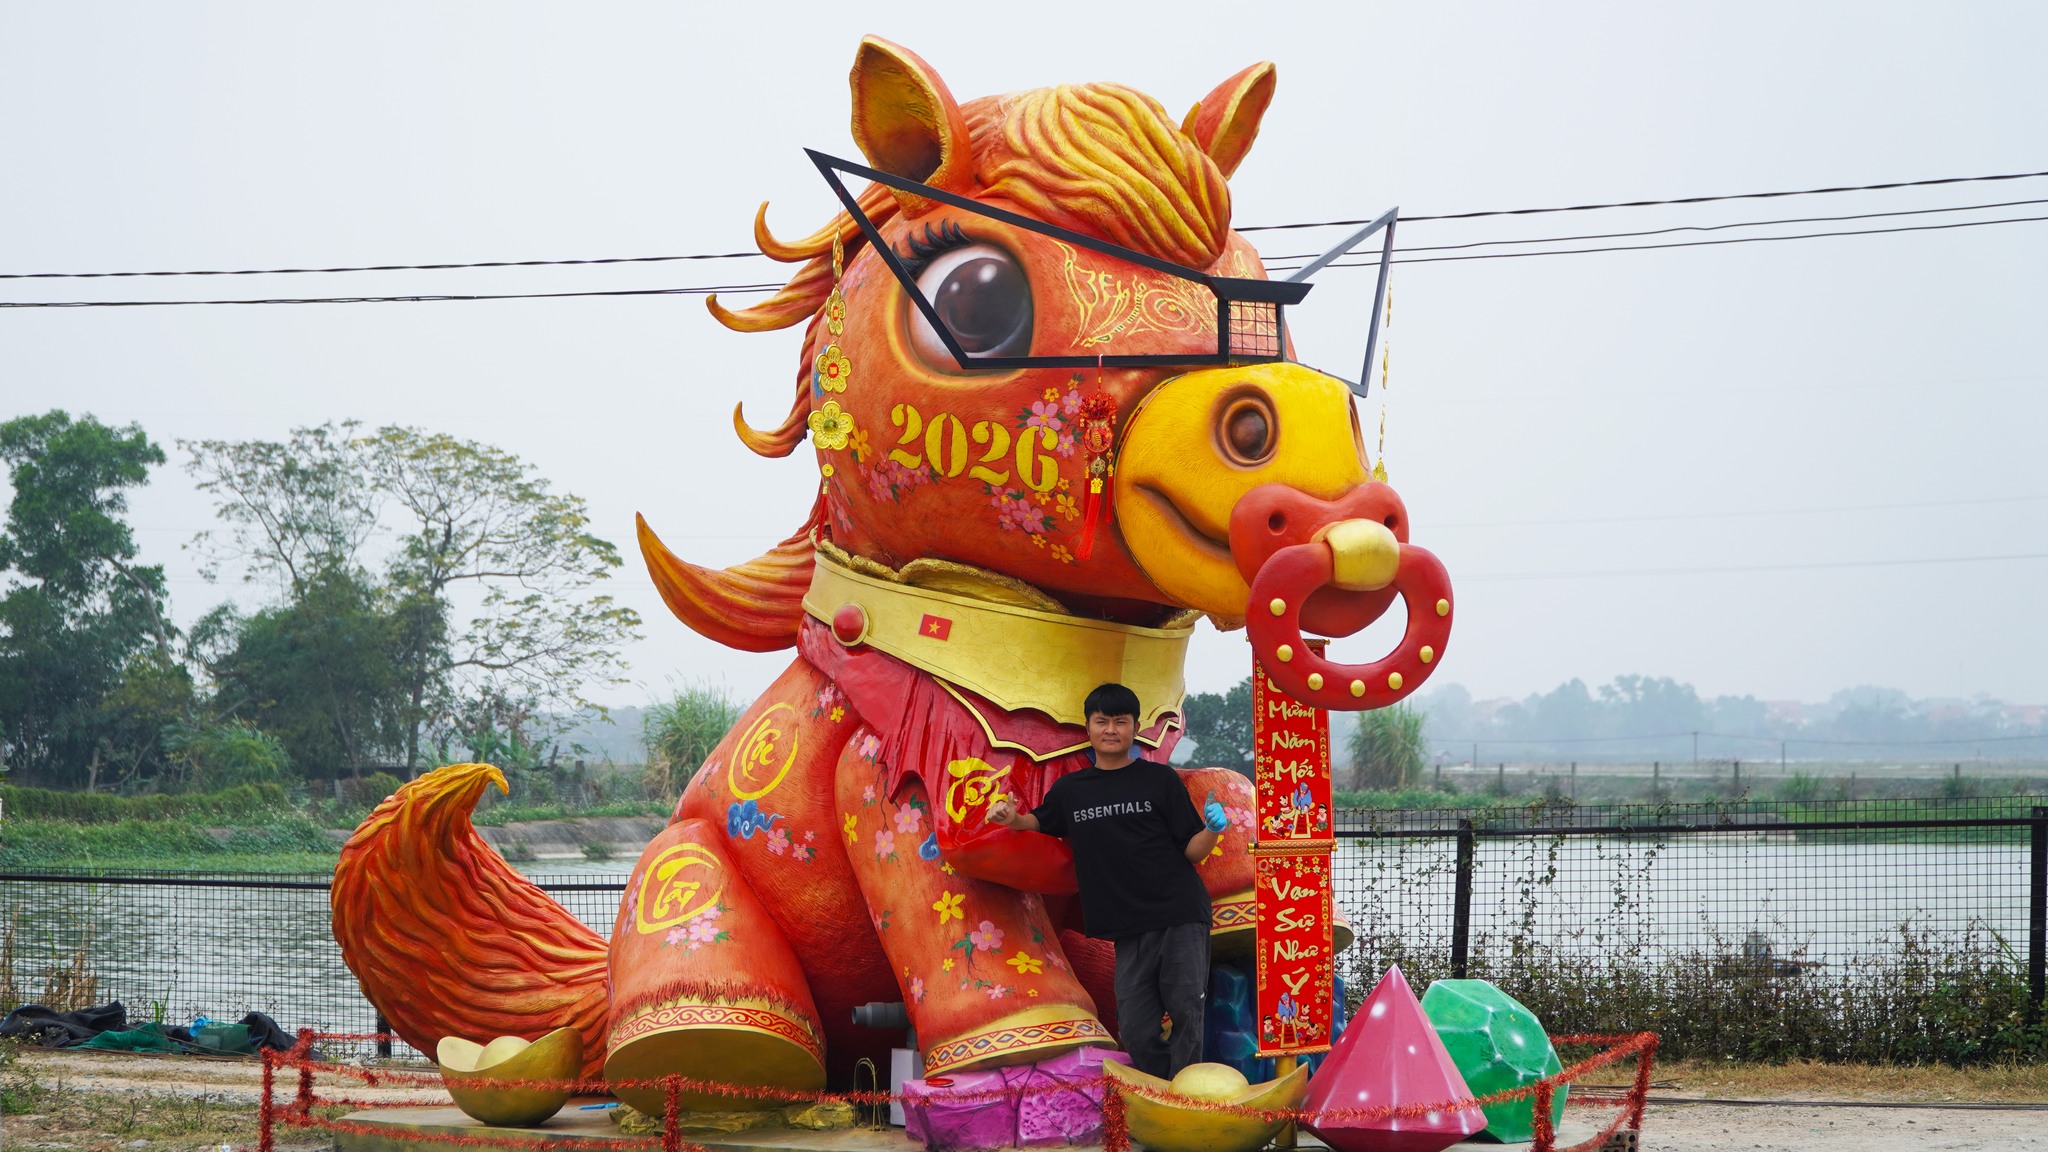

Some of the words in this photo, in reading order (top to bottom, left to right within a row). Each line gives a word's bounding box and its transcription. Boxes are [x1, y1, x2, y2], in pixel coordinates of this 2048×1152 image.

[889, 403, 1059, 493] 2026
[1268, 700, 1316, 730] Mừng
[1271, 730, 1316, 753] Năm
[1274, 759, 1316, 784] Mới
[1073, 801, 1152, 823] ESSENTIALS
[1271, 877, 1318, 901] Vạn
[1274, 907, 1316, 932] Sự
[1273, 938, 1319, 963] Như
[1281, 967, 1310, 996] Ý
